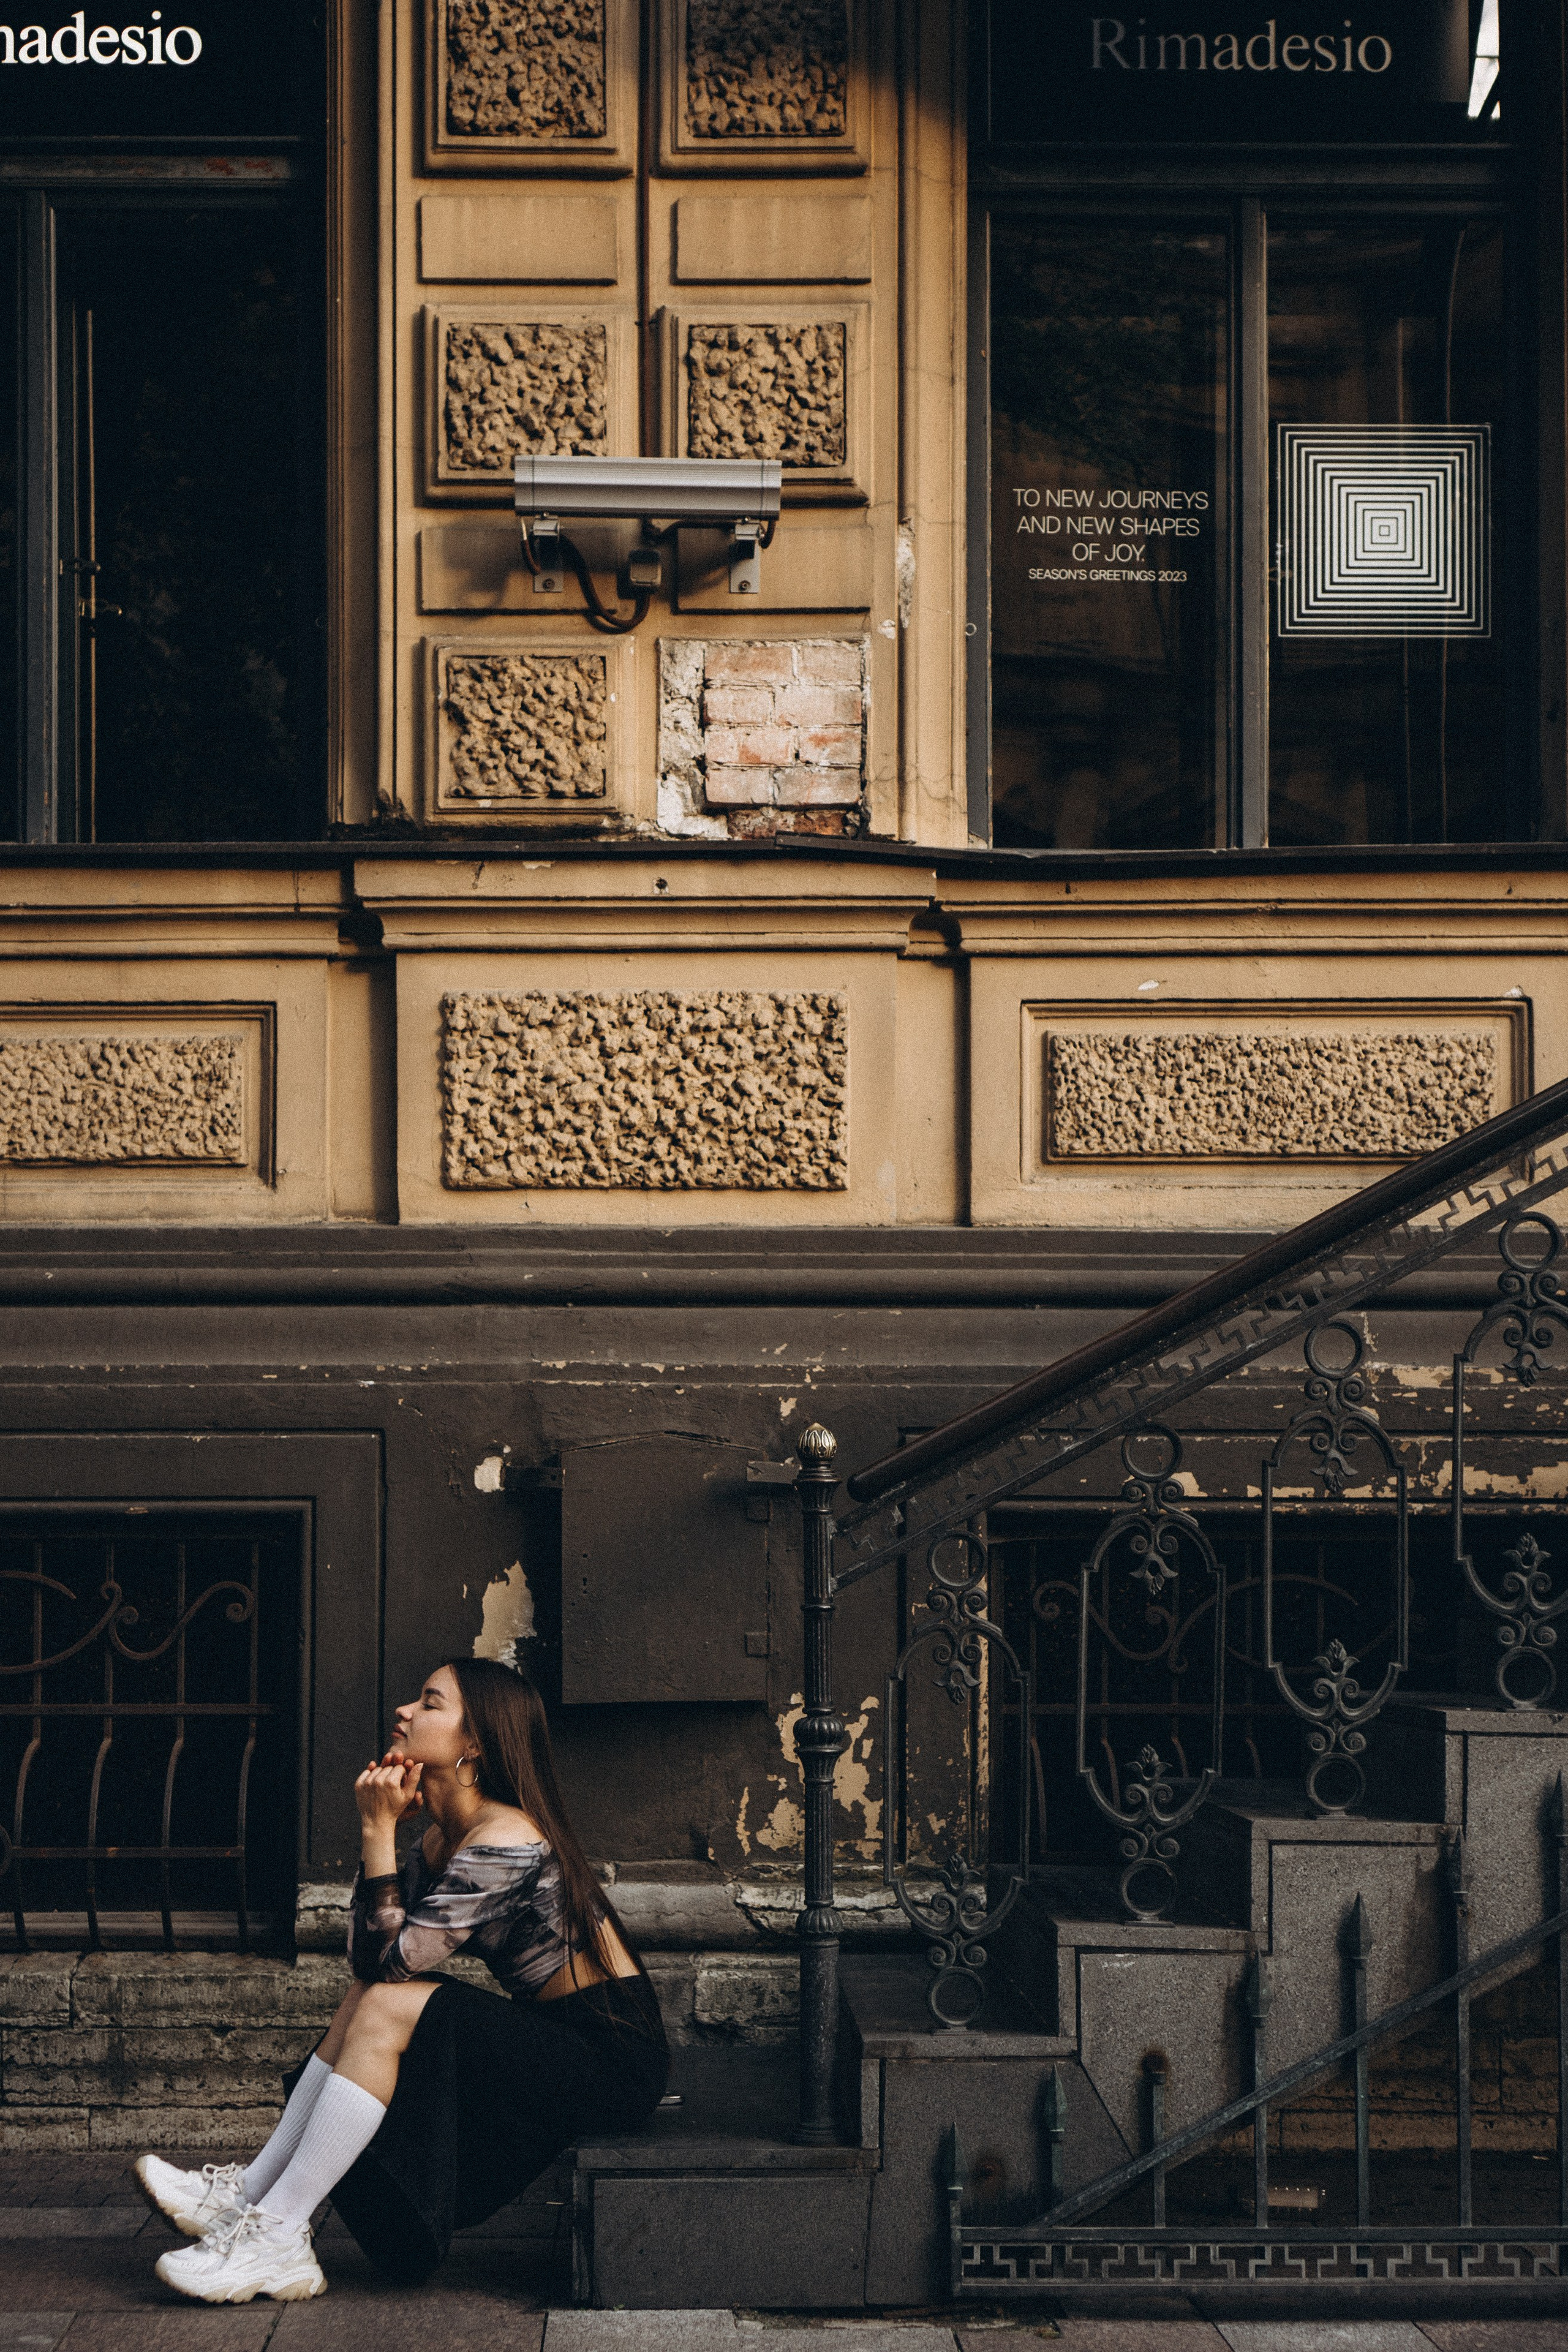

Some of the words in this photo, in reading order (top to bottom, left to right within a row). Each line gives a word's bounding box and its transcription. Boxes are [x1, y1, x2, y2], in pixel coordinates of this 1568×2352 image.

[1090, 18, 1393, 73] Rimadesio
[1012, 488, 1041, 507] TO
[1046, 489, 1095, 508] NEW
[1098, 490, 1209, 510] JOURNEYS
[1017, 516, 1061, 535] AND
[1066, 516, 1115, 535] NEW
[1120, 517, 1200, 537] SHAPES
[1072, 543, 1100, 562] OF
[1104, 544, 1146, 563] JOY.
[1028, 568, 1087, 580] SEASON'S
[1089, 570, 1156, 581] GREETINGS
[1158, 571, 1187, 582] 2023
